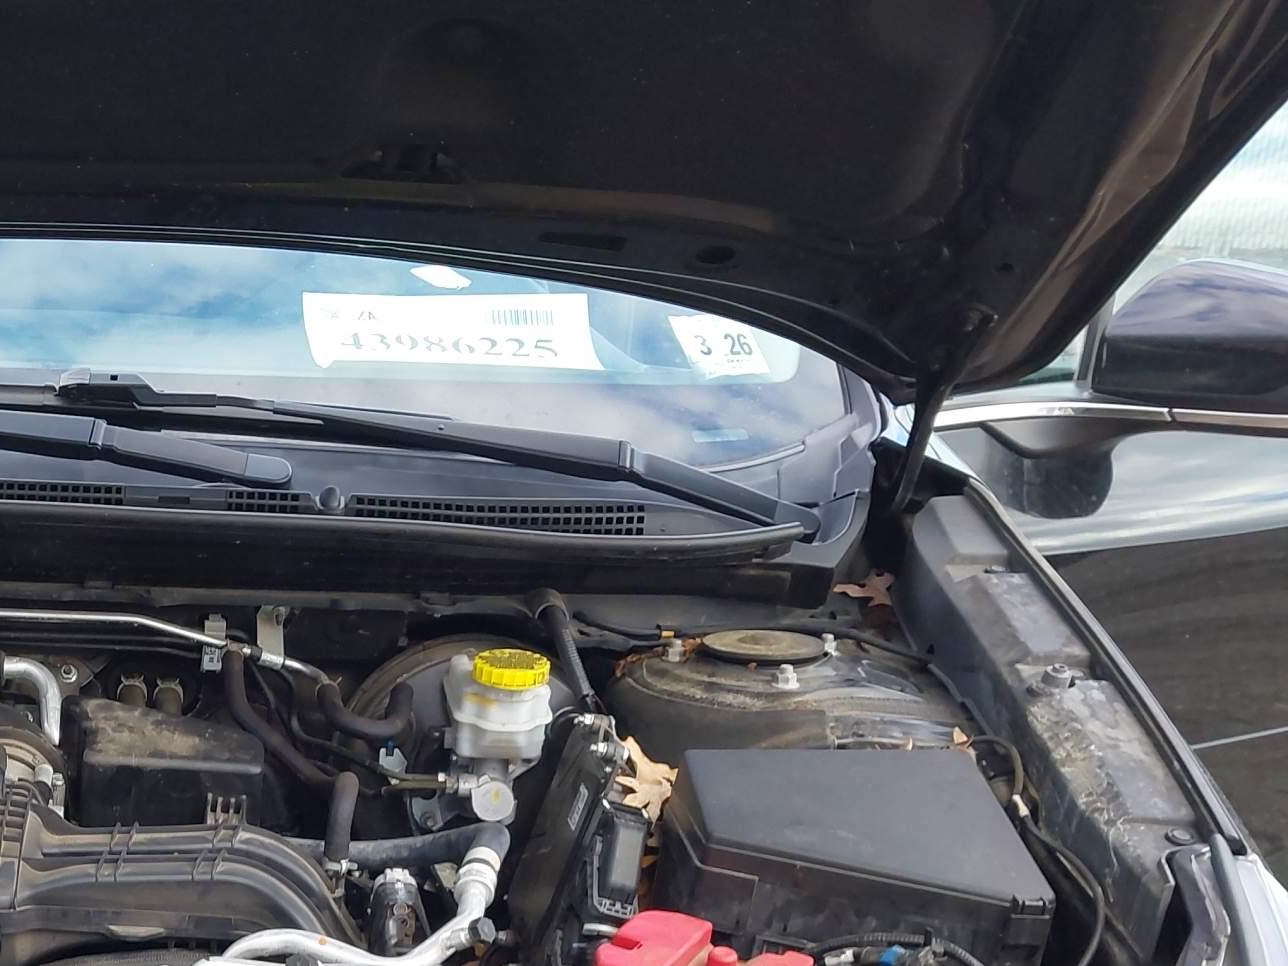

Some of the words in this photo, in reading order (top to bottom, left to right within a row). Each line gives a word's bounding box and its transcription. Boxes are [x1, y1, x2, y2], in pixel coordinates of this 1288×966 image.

[341, 332, 559, 358] 43986225
[694, 334, 713, 356] 3
[724, 333, 753, 356] 26
